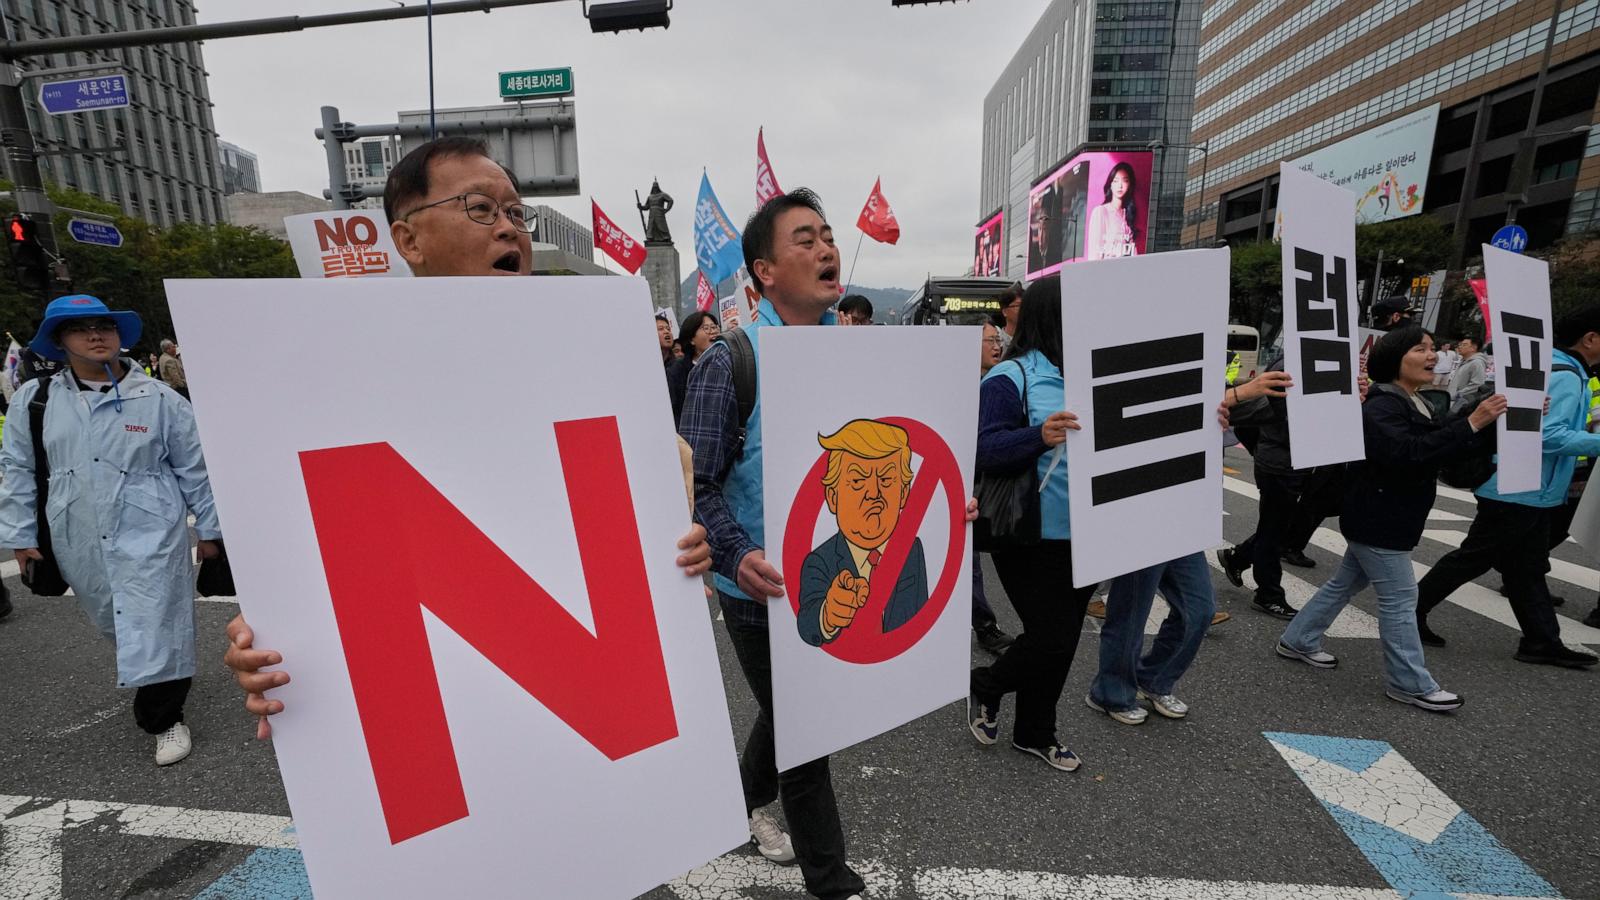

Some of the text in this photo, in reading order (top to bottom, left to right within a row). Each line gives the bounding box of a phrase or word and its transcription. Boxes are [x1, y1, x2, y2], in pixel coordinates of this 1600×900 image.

[78, 79, 123, 96] 새문안로
[507, 73, 563, 91] 세종대로사거리
[76, 96, 126, 108] Saemunan-ro
[1353, 162, 1383, 181] 아름다운
[1385, 151, 1416, 172] 일이란다
[313, 215, 378, 252] NO
[321, 251, 391, 279] 트럼프!
[744, 284, 762, 311] N
[944, 297, 961, 311] 703
[1294, 247, 1352, 396] 럼
[1500, 310, 1546, 432] 프
[1091, 332, 1206, 506] 트
[298, 416, 678, 845] N
